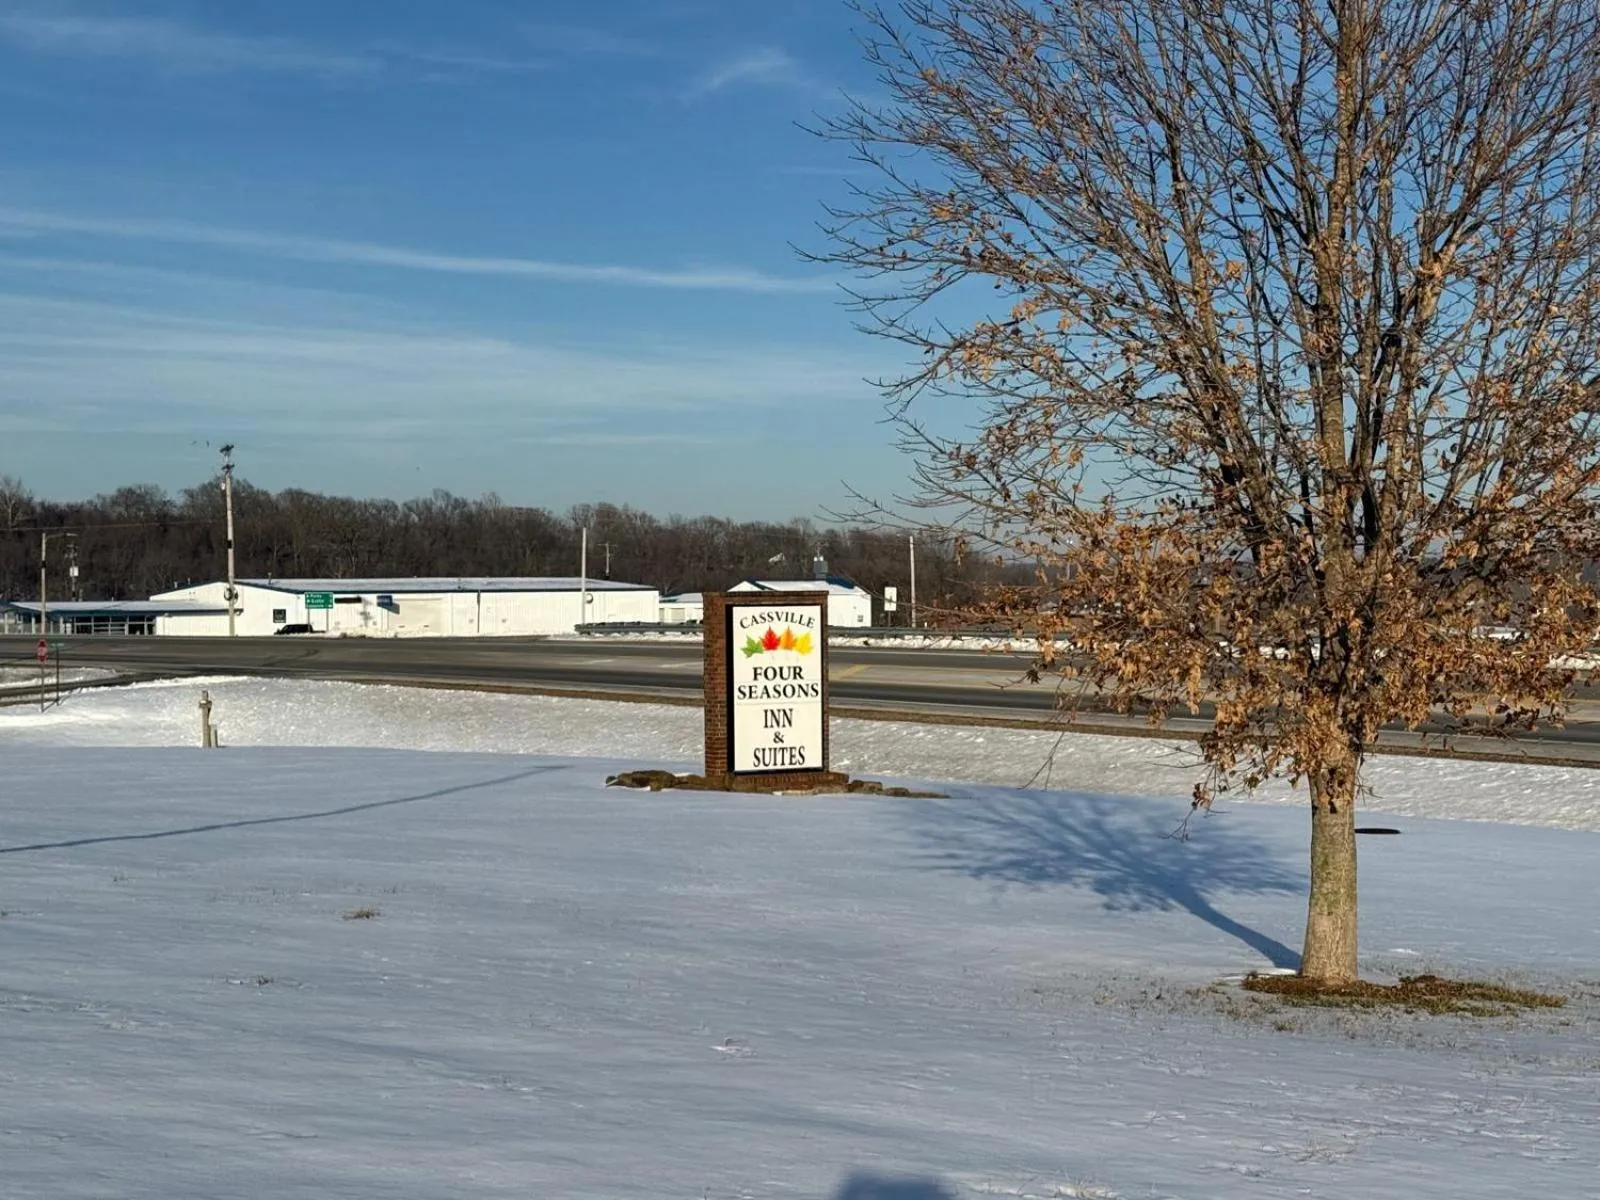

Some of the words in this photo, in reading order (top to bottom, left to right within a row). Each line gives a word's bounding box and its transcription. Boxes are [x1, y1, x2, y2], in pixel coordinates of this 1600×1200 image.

[739, 611, 815, 630] CASSVILLE
[752, 666, 804, 681] FOUR
[737, 683, 819, 700] SEASONS
[763, 708, 793, 728] INN
[773, 731, 785, 744] &
[753, 745, 805, 768] SUITES
